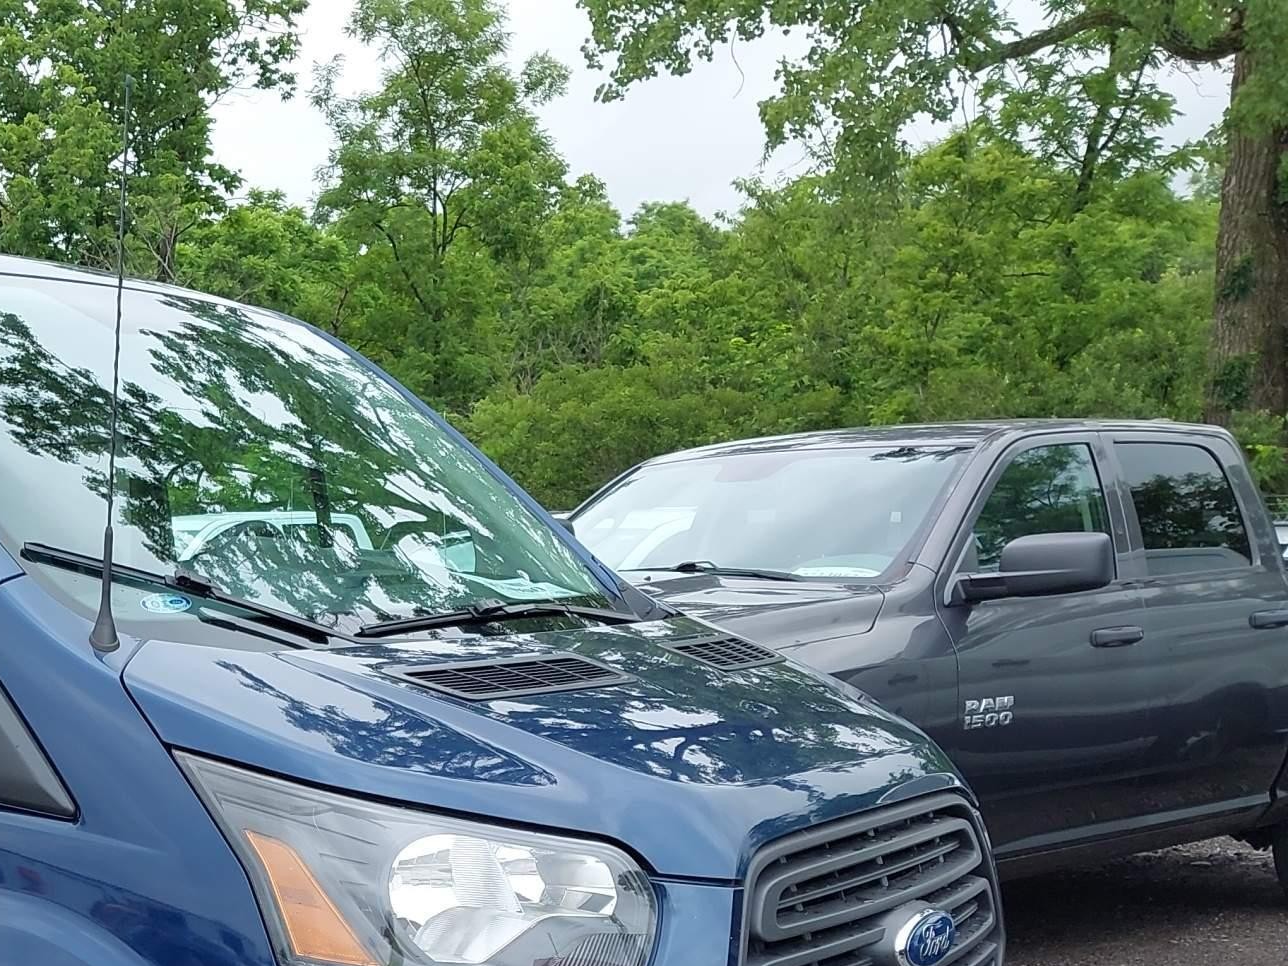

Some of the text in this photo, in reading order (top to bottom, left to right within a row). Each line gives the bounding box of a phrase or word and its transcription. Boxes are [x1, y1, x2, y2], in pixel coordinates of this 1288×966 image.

[965, 696, 1014, 713] RAM
[963, 711, 1013, 730] 1500
[920, 920, 951, 961] Ford
